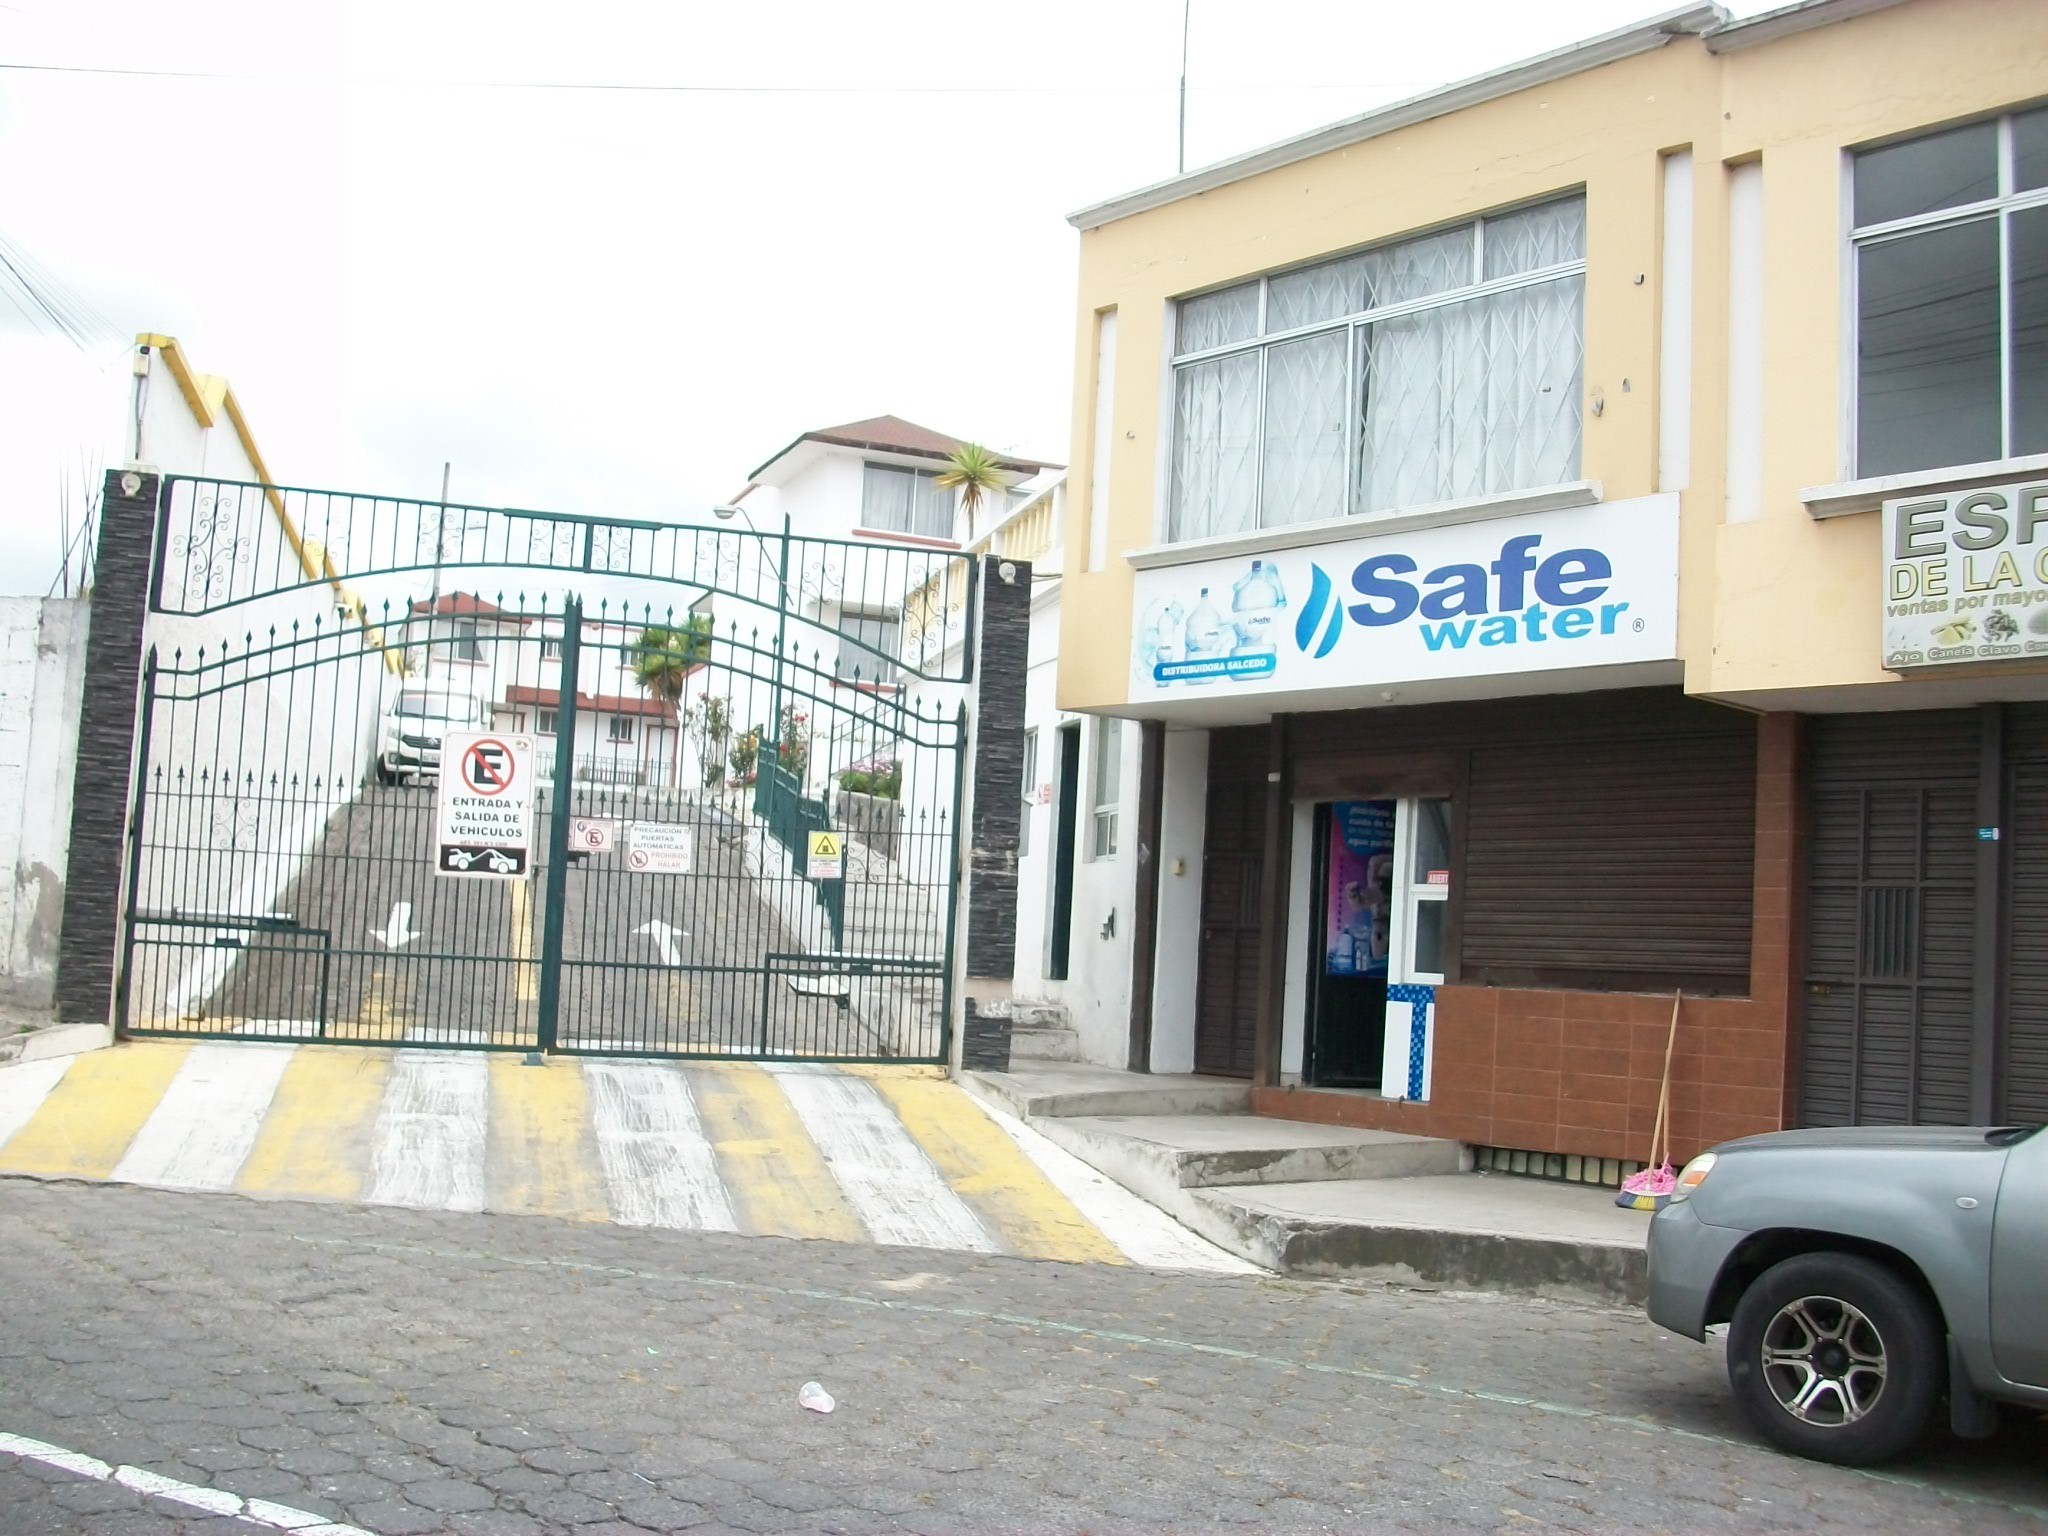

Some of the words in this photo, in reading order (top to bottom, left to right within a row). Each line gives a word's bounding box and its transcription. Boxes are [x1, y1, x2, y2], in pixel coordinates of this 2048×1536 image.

[1348, 534, 1612, 627] Safe
[1890, 559, 1948, 601] DE
[1963, 551, 2022, 592] LA
[1887, 598, 1949, 618] ventas
[1954, 594, 1988, 614] por
[1992, 589, 2048, 608] mayo
[1419, 602, 1630, 651] water
[1929, 646, 1974, 659] Canela
[1979, 644, 2020, 656] Clavo
[1891, 652, 1920, 663] Ajo
[1162, 661, 1226, 676] DISTRIBUIDORA
[1227, 658, 1268, 671] SALCEDO
[452, 796, 511, 808] ENTRADA
[516, 800, 524, 809] Y
[455, 811, 499, 822] SALIDA
[504, 813, 519, 823] DE
[451, 825, 523, 838] VEHICULOS
[641, 834, 674, 842] PUERTAS
[651, 851, 688, 860] PROHIBIDO
[657, 860, 681, 869] HALAR
[1429, 874, 1448, 883] ABIERT
